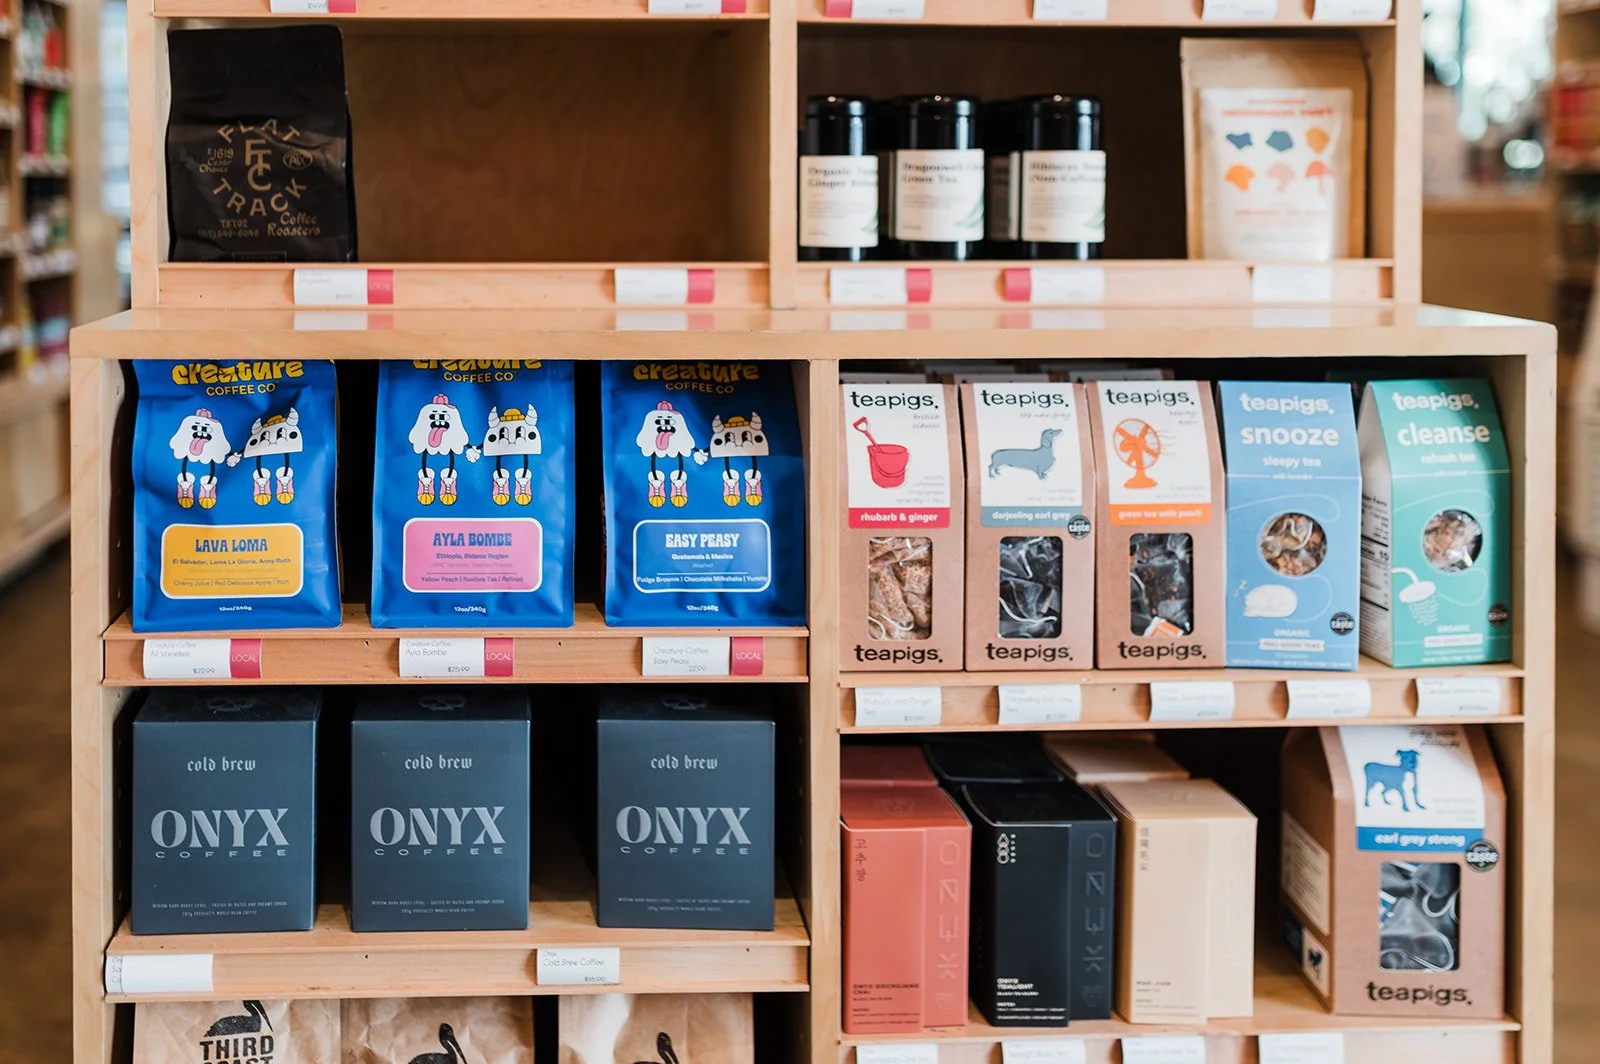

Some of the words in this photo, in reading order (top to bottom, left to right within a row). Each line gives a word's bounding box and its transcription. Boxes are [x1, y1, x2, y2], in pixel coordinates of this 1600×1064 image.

[217, 119, 301, 144] FLAT
[213, 177, 307, 217] TRACK
[280, 211, 317, 225] Coffee
[267, 222, 320, 236] Roasters
[172, 361, 304, 385] creature
[444, 371, 492, 383] COFFEE
[494, 371, 514, 382] CO
[633, 362, 760, 383] creature
[206, 384, 255, 396] COFFEE
[257, 383, 276, 394] CO
[665, 382, 713, 393] COFFEE
[716, 385, 734, 394] CO
[850, 391, 939, 410] teapigs.
[980, 390, 1069, 409] teapigs.
[1105, 389, 1195, 407] teapigs.
[1239, 393, 1334, 415] teapigs.
[1392, 392, 1479, 411] teapigs.
[1241, 426, 1339, 446] snooze
[1398, 422, 1490, 446] cleanse
[1263, 456, 1299, 469] sleepy
[1302, 457, 1321, 467] tea
[1421, 453, 1457, 464] refresh
[1458, 452, 1476, 463] tea
[861, 513, 897, 522] rhubarb
[899, 513, 906, 521] &
[908, 513, 938, 523] ginger
[992, 512, 1033, 521] darjeeling
[1052, 512, 1071, 521] grey
[1119, 511, 1141, 520] green
[1160, 510, 1177, 518] with
[1179, 510, 1202, 519] peach
[195, 539, 228, 553] LAVA
[232, 538, 268, 552] LOMA
[432, 533, 465, 546] AYLA
[468, 532, 512, 547] BOMBE
[665, 533, 698, 548] EASY
[701, 533, 739, 548] PEASY
[486, 653, 512, 661] LOCAL
[736, 652, 761, 660] LOCAL
[854, 645, 943, 663] teapigs.
[985, 643, 1073, 661] teapigs.
[1118, 641, 1206, 660] teapigs.
[187, 756, 216, 772] cold
[222, 756, 256, 772] brew
[405, 754, 433, 770] cold
[439, 754, 472, 769] brew
[650, 754, 679, 770] cold
[684, 754, 718, 770] brew
[151, 808, 290, 848] ONYX
[370, 806, 506, 846] ONYX
[616, 805, 752, 844] ONYX
[1375, 833, 1398, 844] earl
[1400, 834, 1426, 847] grey
[1427, 833, 1465, 846] strong
[155, 849, 287, 859] COFFEE
[374, 847, 503, 856] COFFEE
[620, 846, 749, 855] COFFEE
[1366, 982, 1473, 1006] teapigs.
[199, 1035, 274, 1061] THIRD
